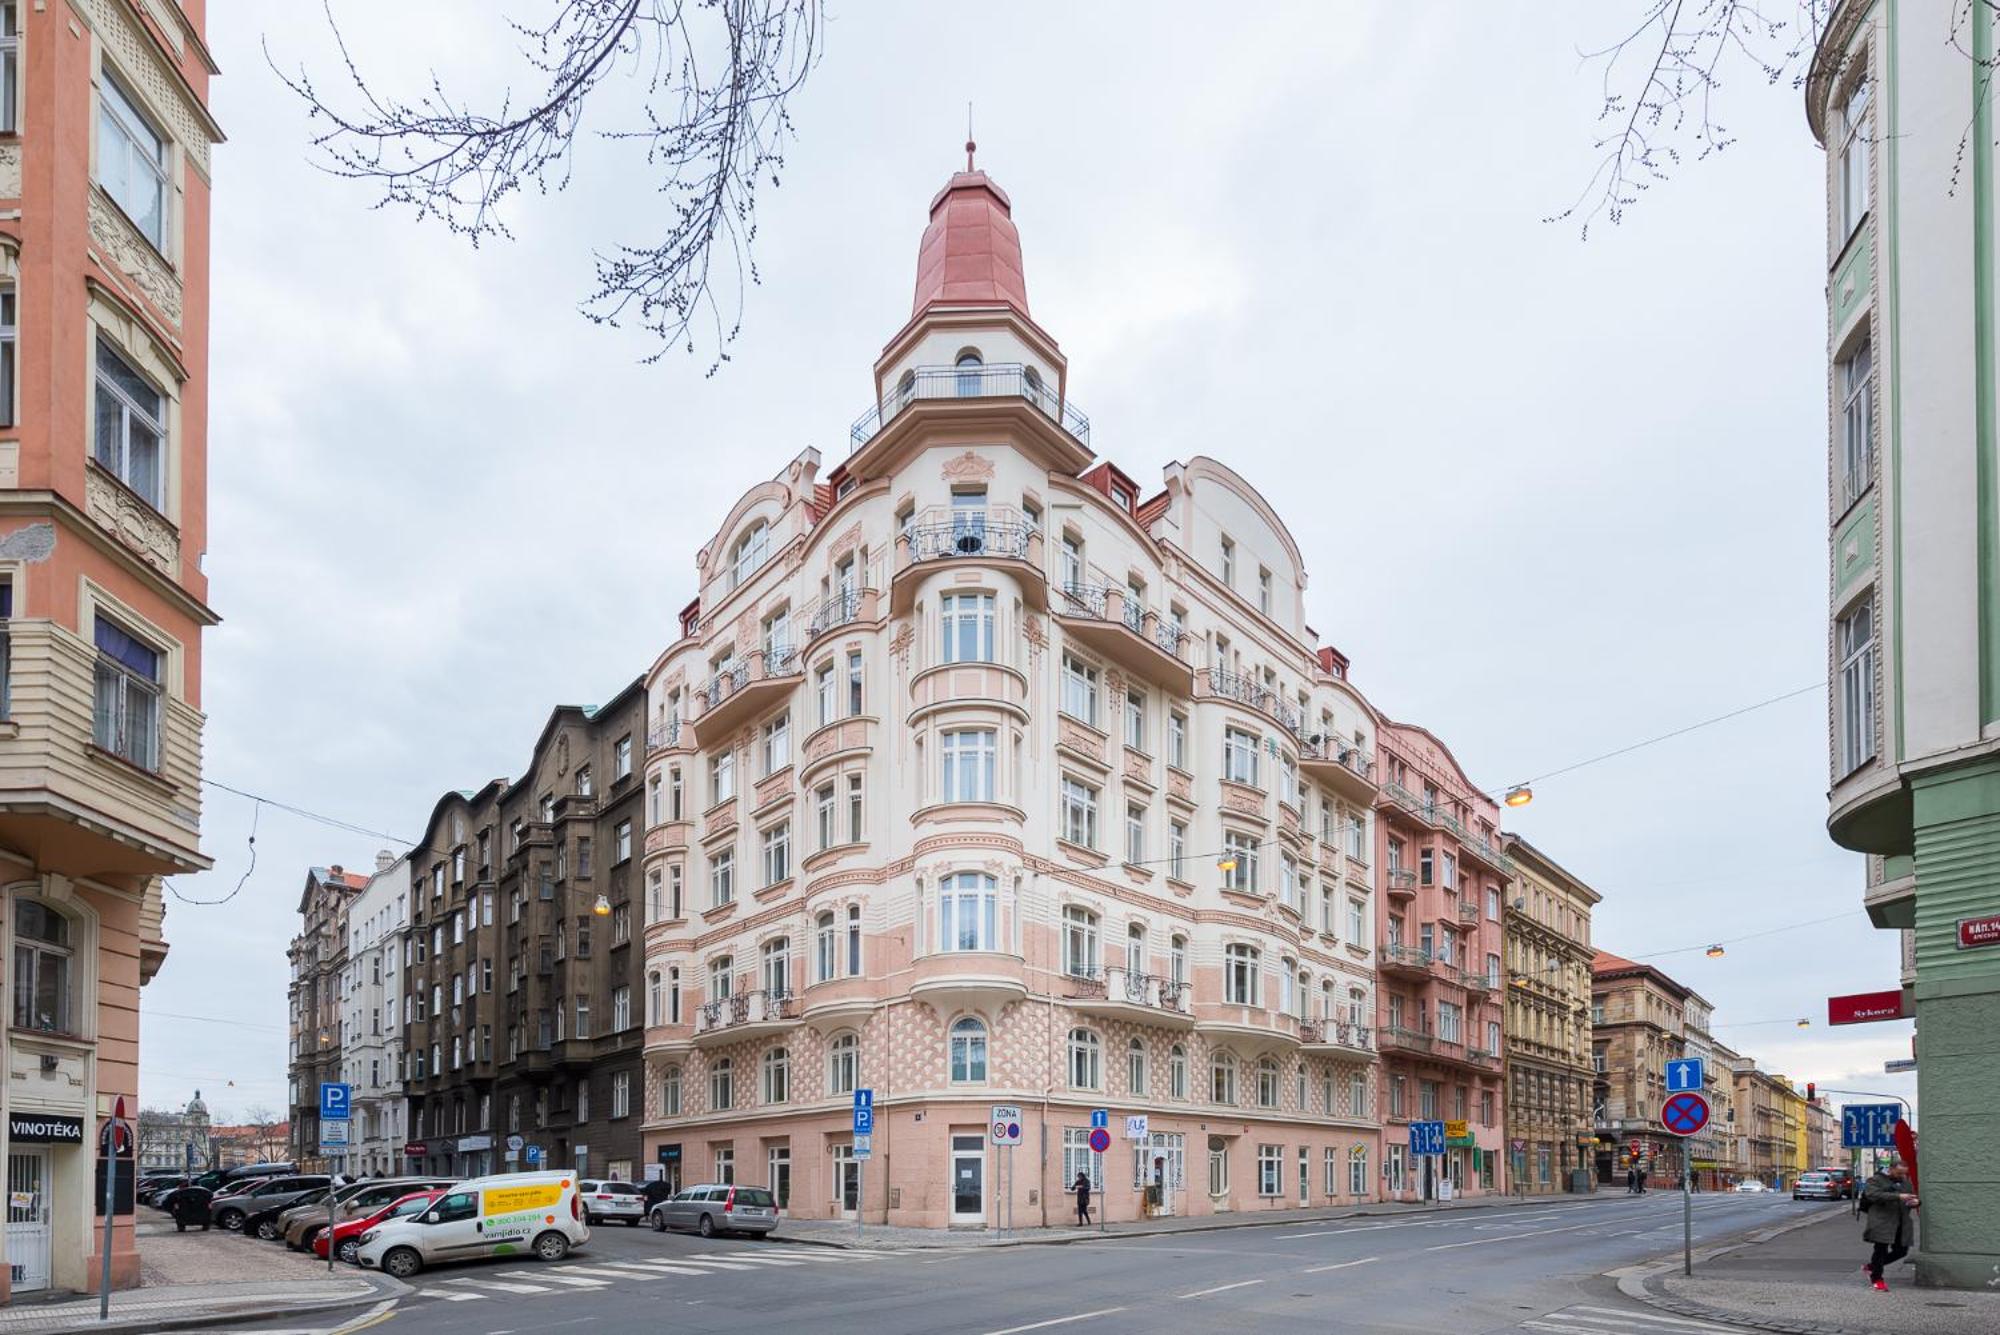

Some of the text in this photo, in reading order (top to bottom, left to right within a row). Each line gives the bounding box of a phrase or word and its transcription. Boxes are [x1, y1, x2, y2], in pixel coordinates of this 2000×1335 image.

[327, 1088, 344, 1108] P
[857, 1111, 868, 1127] P
[11, 1121, 81, 1138] VINOTÉKA
